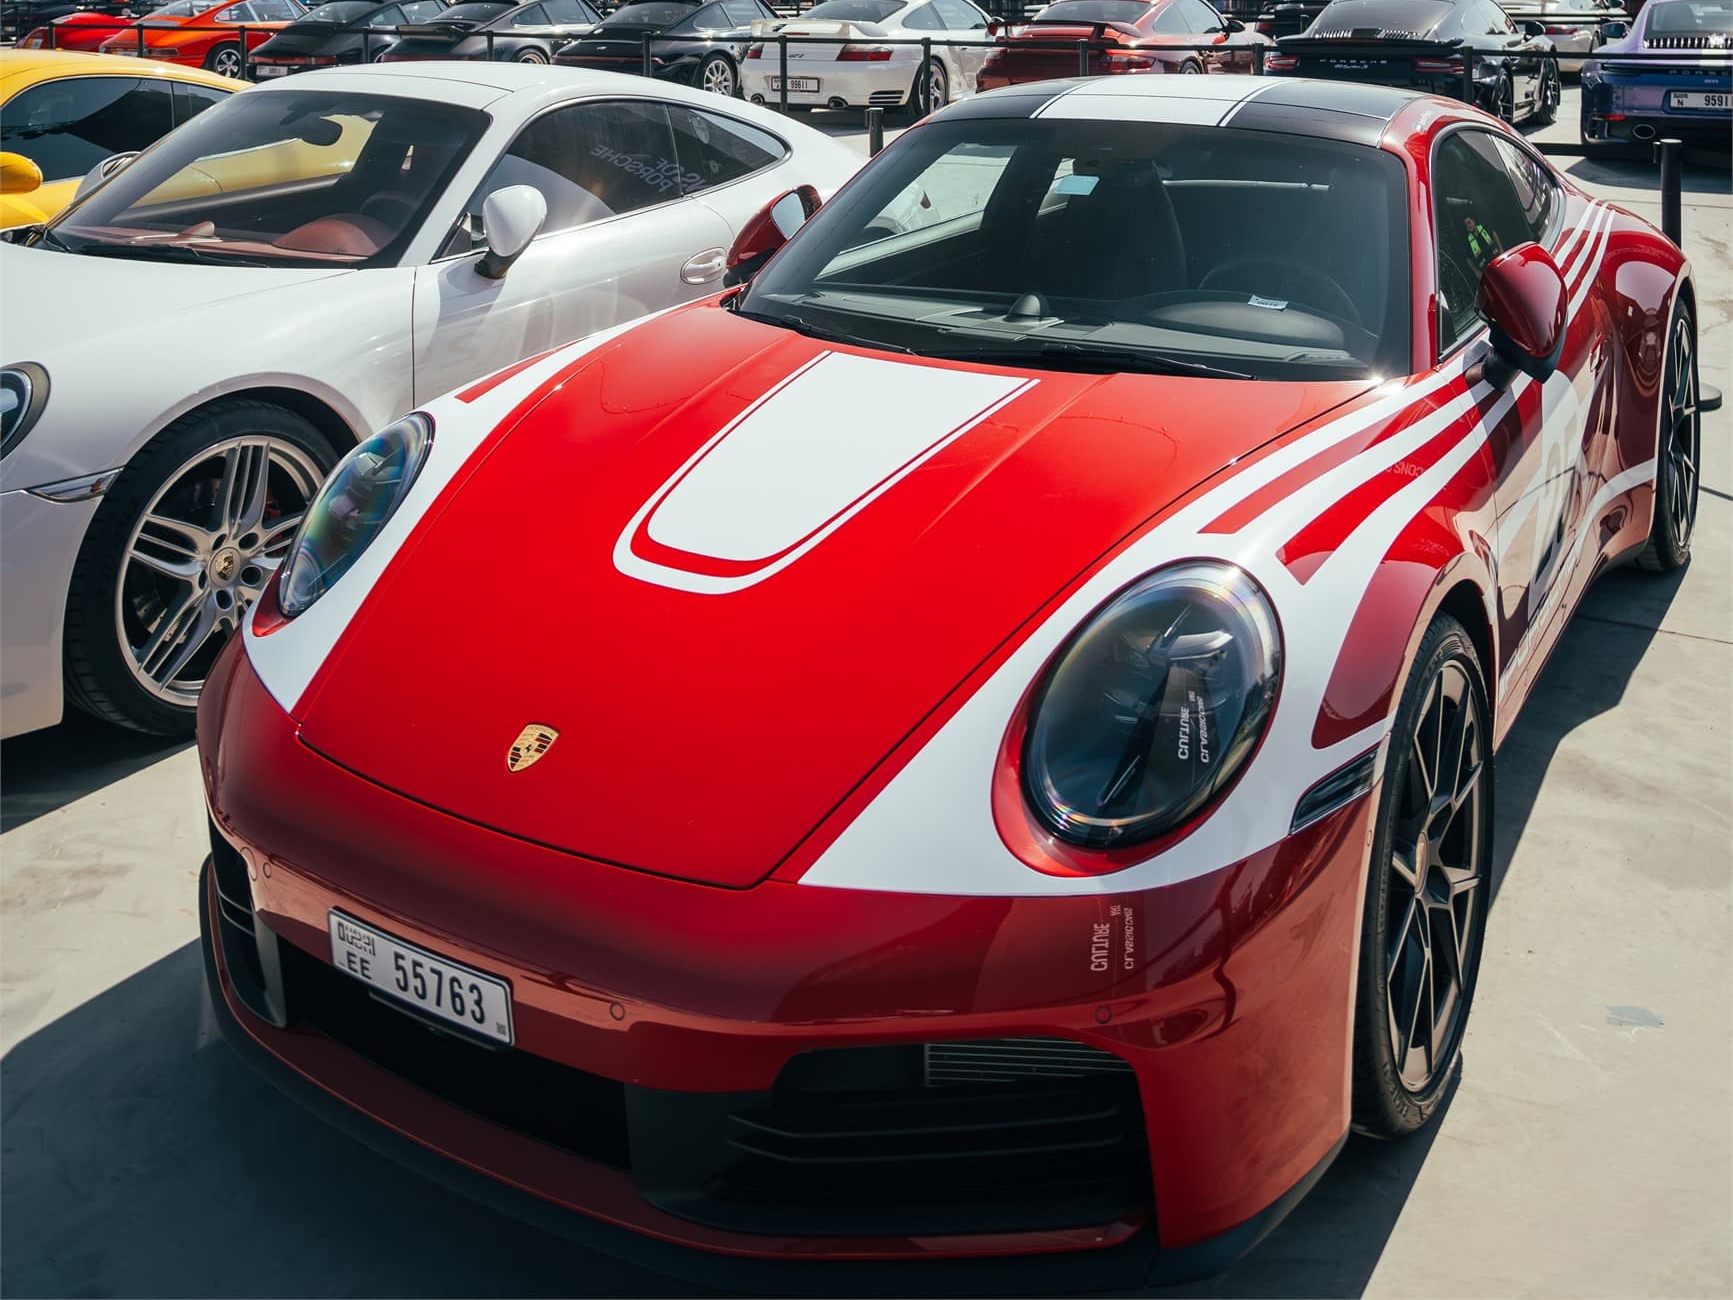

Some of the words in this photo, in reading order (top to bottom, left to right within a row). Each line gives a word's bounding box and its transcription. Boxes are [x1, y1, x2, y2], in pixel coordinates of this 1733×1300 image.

[1677, 99, 1684, 107] N
[1704, 94, 1733, 107] 9591
[347, 951, 373, 980] EE
[393, 951, 486, 1025] 55763
